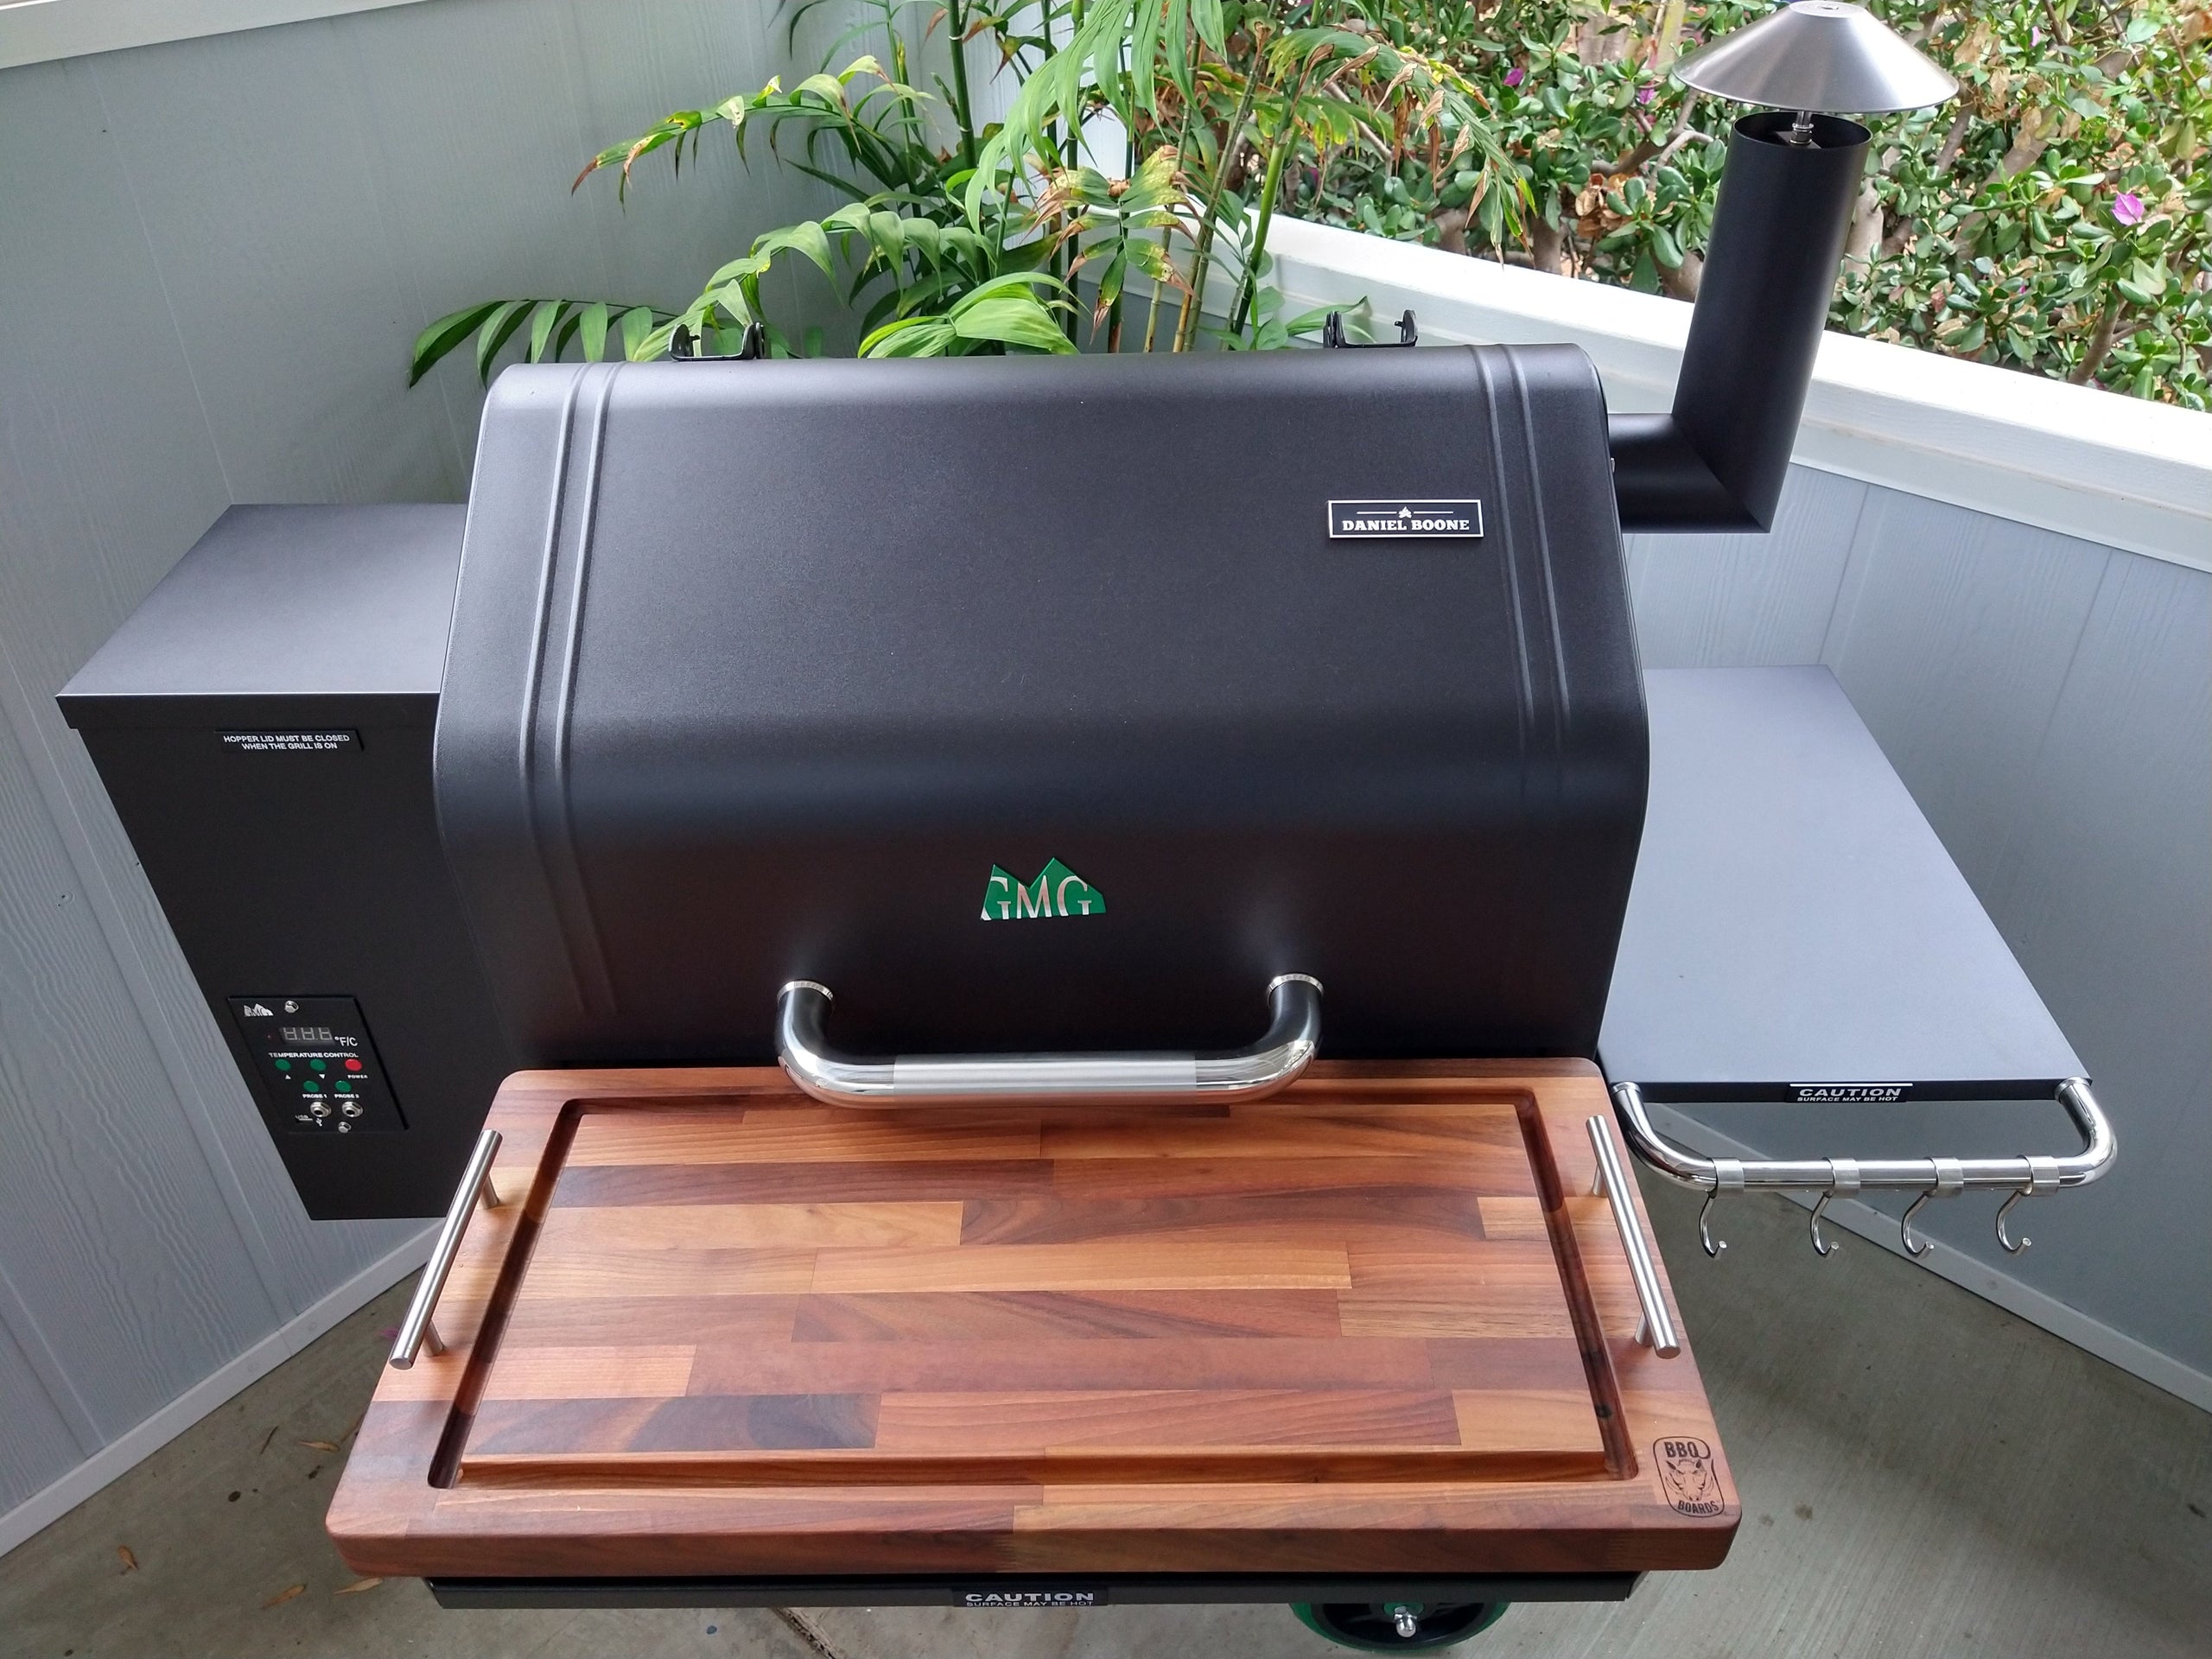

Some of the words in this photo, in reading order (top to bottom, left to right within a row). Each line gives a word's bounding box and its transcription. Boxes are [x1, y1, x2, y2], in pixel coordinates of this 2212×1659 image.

[1342, 520, 1407, 531] DANIEL
[1411, 519, 1470, 531] BOONE
[980, 874, 1092, 921] GMG
[1799, 1088, 1901, 1096] CAUTION
[1664, 1441, 1700, 1459] BBQ
[1677, 1499, 1719, 1514] BOARDS
[965, 1592, 1094, 1602] CAUTION
